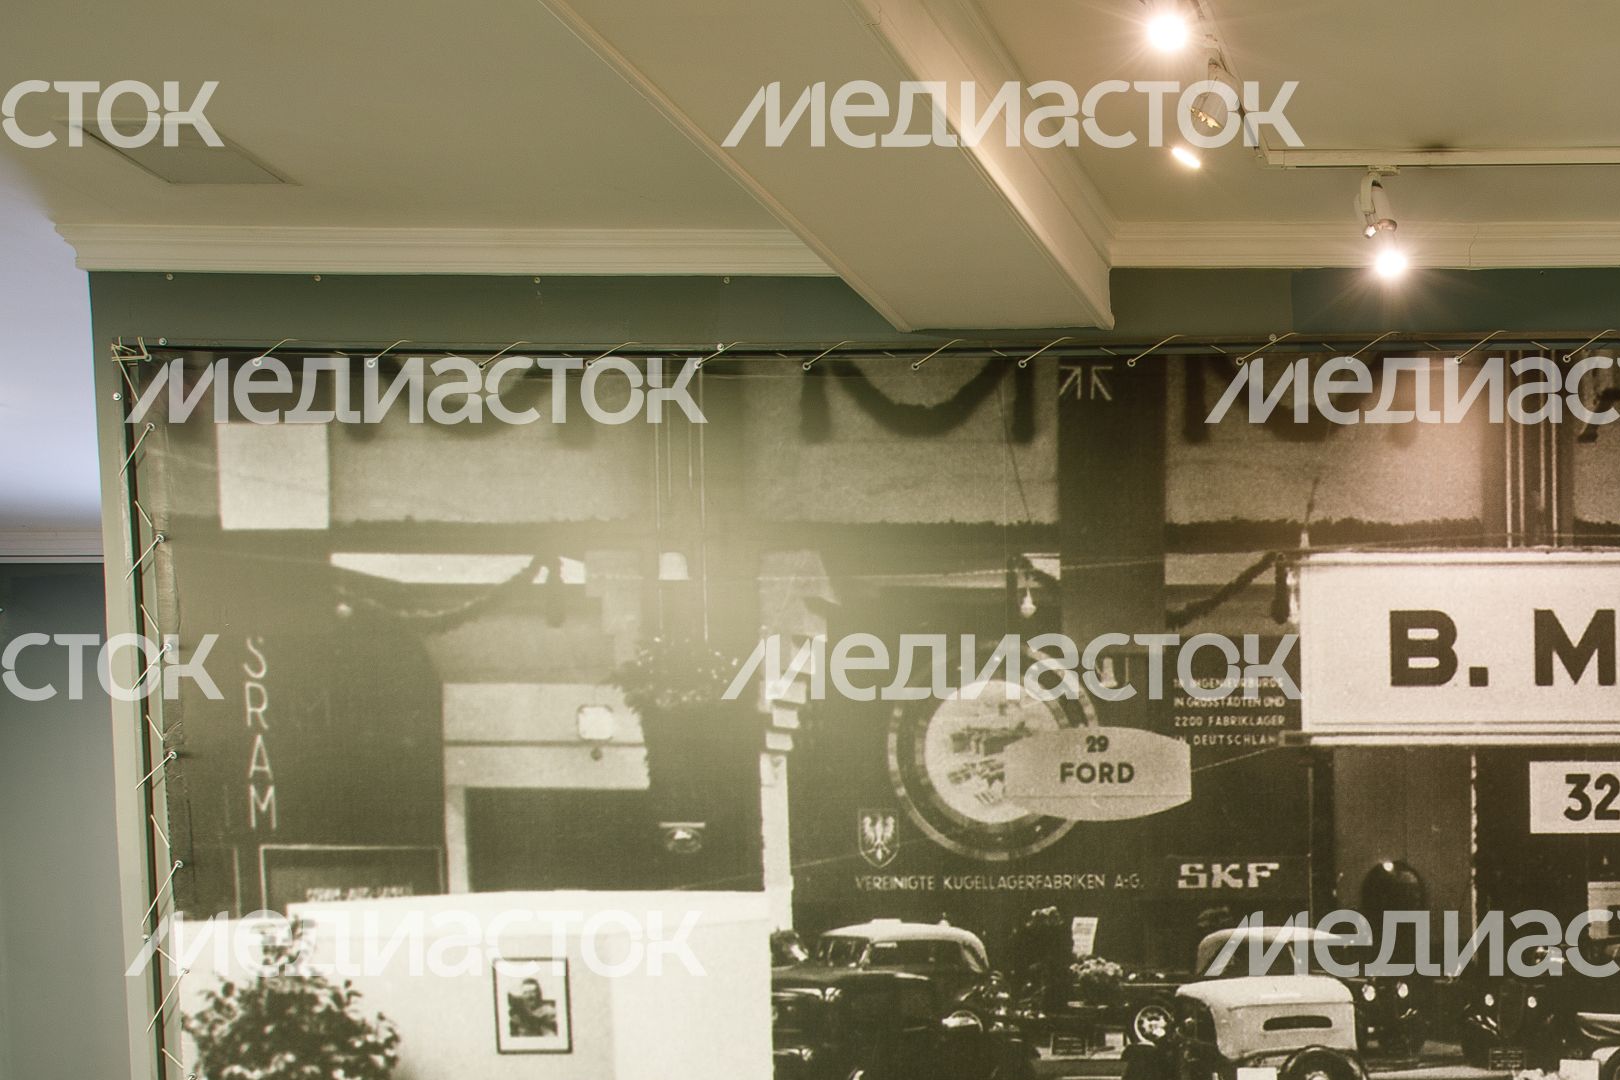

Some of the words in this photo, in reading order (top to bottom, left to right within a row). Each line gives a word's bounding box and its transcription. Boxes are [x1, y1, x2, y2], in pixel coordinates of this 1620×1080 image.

[1389, 609, 1489, 687] B.
[1086, 735, 1109, 753] 29
[1194, 734, 1277, 746] DEUTSCHLAN
[1060, 762, 1135, 784] FORD
[1563, 773, 1620, 821] 32
[1177, 863, 1280, 889] SKF
